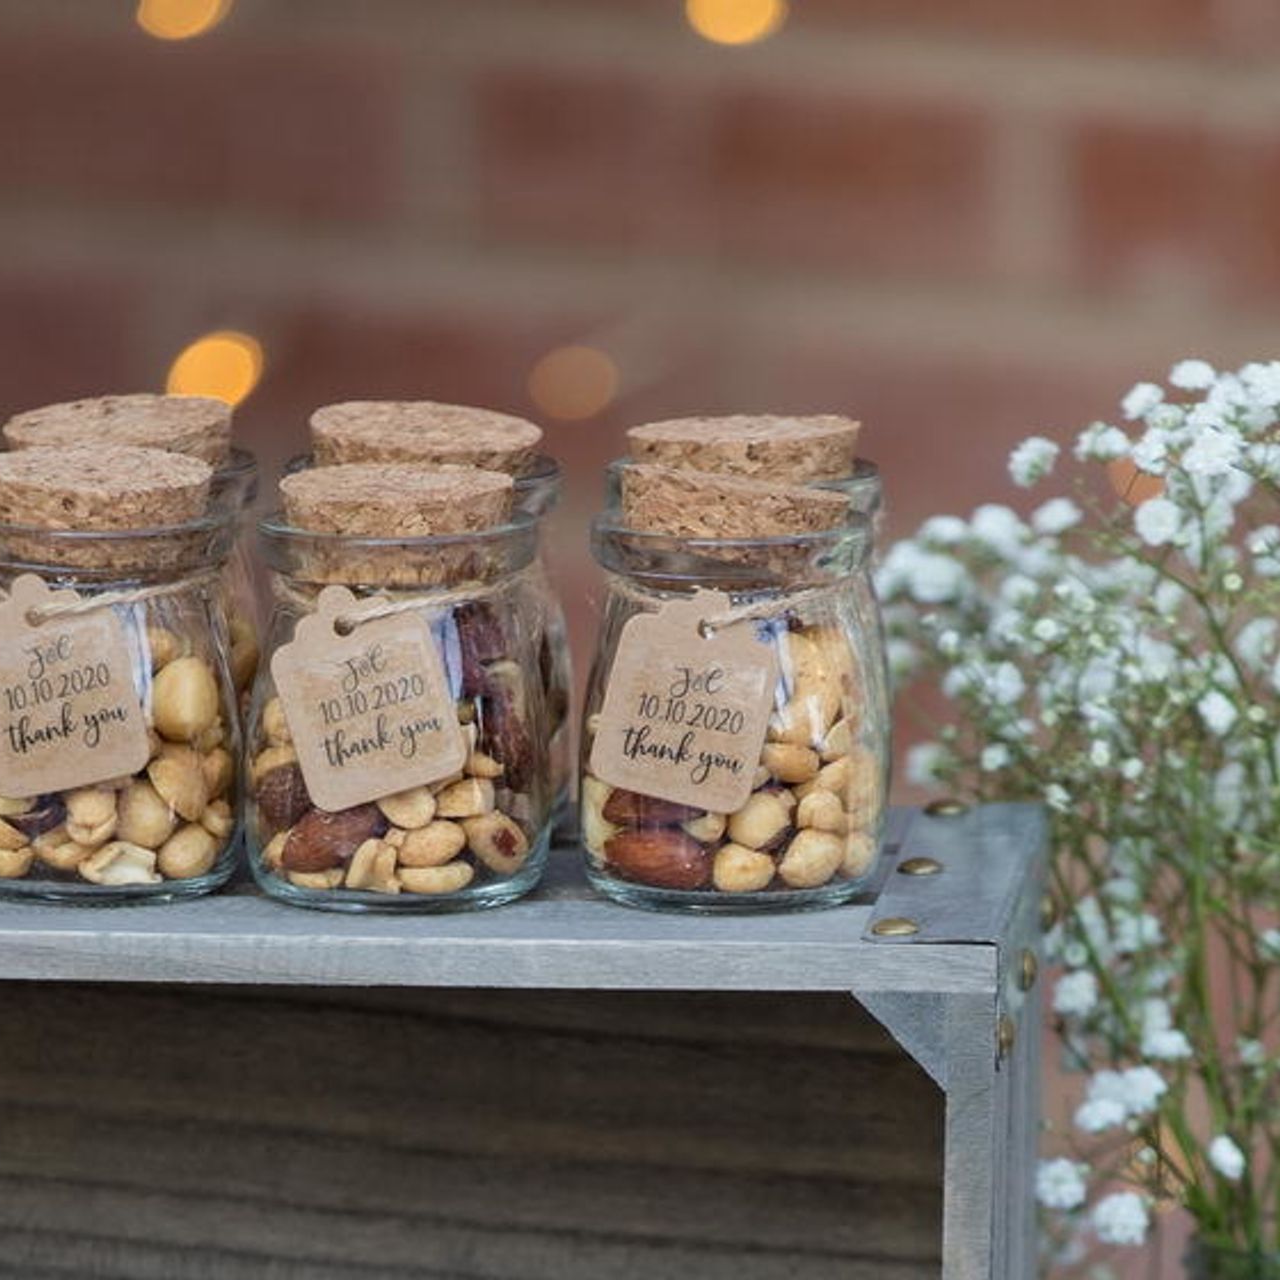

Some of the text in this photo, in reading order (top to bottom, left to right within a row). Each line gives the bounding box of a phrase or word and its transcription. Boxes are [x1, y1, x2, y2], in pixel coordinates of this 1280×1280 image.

[3, 661, 111, 712] 10.10.2020
[318, 674, 424, 725] 10.10.2020
[3, 701, 127, 753] thank you
[638, 692, 744, 734] 10.10.2020
[320, 713, 442, 767] thank you
[622, 725, 743, 785] thank you
